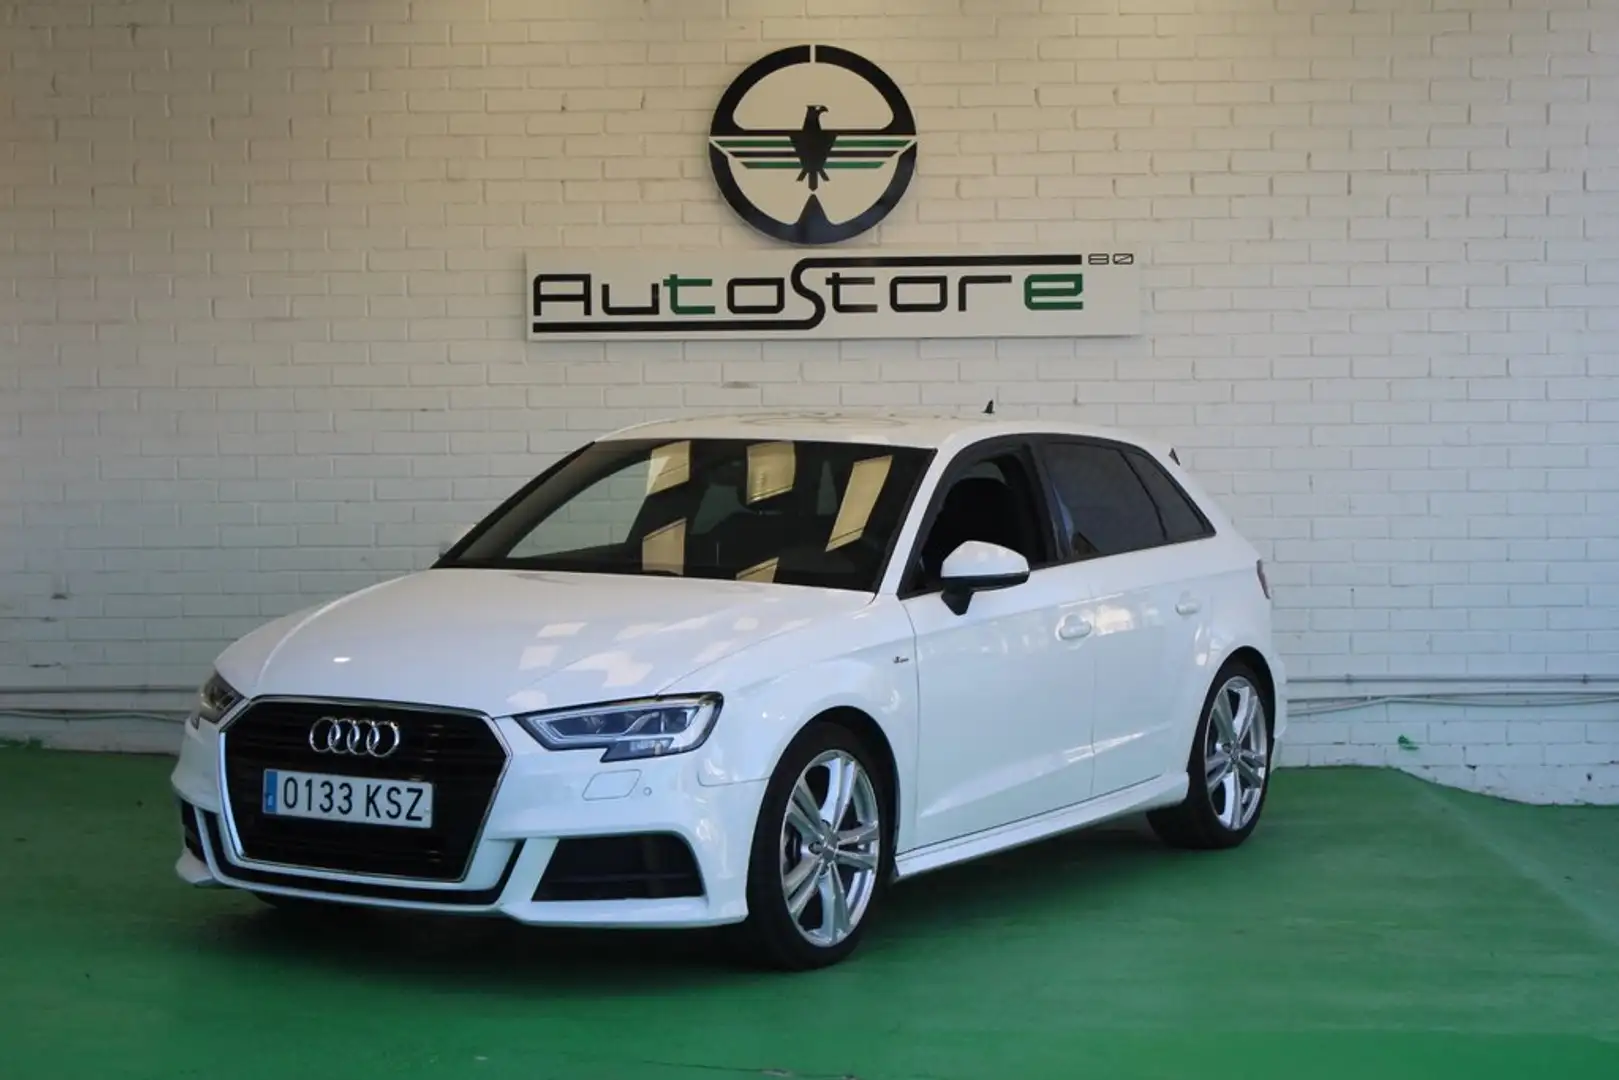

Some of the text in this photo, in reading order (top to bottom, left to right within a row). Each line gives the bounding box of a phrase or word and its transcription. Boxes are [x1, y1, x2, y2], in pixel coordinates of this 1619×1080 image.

[533, 253, 1134, 332] AutoStore 80
[283, 777, 424, 821] 0133 KSZ
